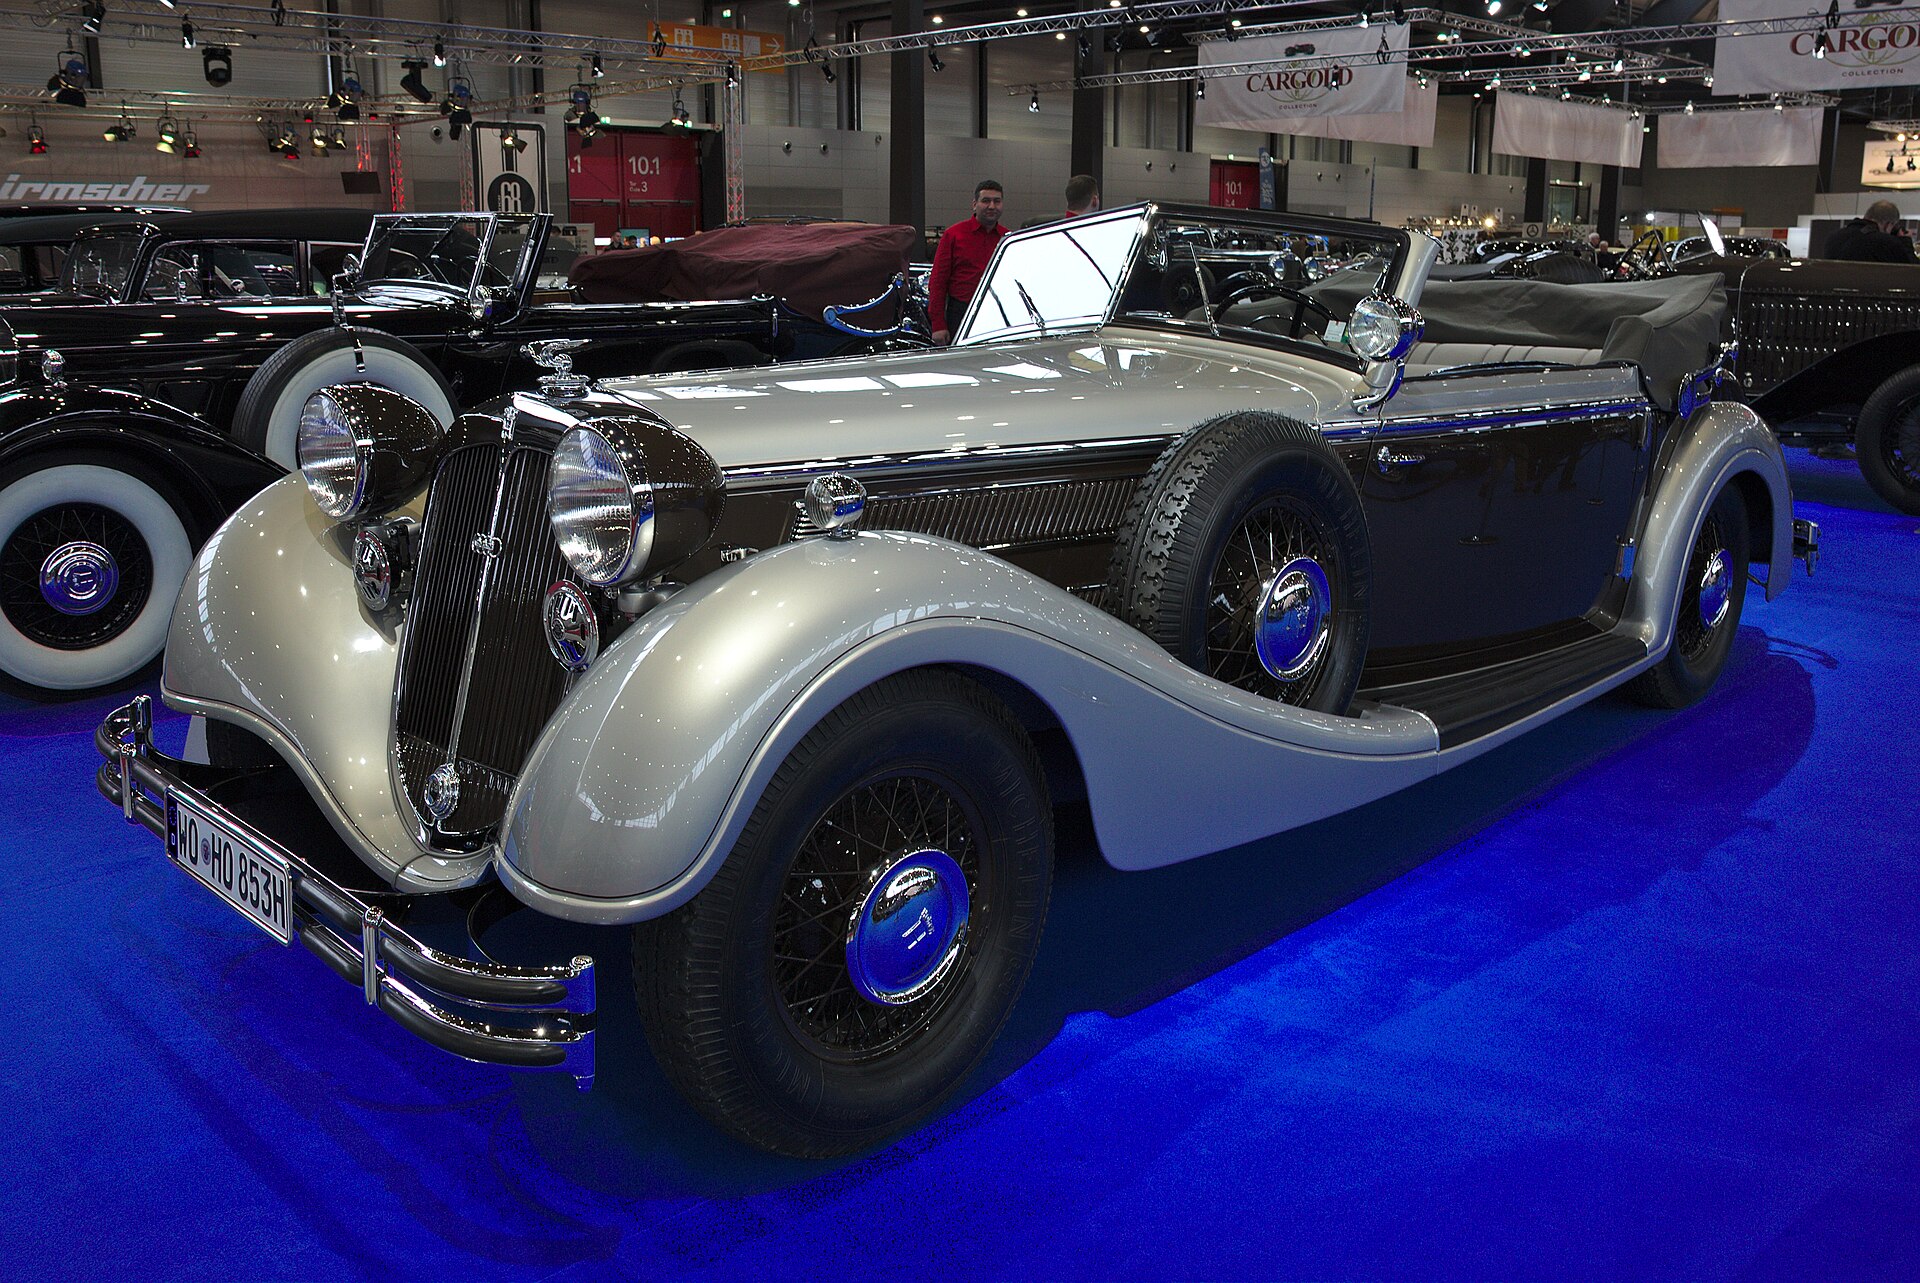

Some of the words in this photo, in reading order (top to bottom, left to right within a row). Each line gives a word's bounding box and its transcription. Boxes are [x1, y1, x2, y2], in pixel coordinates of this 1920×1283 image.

[1790, 24, 1920, 56] CARGO
[1841, 68, 1904, 77] COLLECTION
[628, 156, 660, 175] 10.1
[0, 174, 211, 202] irmscher
[500, 181, 521, 213] 68
[641, 181, 648, 193] 3
[1225, 181, 1242, 196] 10.1
[178, 810, 198, 866] WO
[212, 832, 233, 891] HO
[239, 852, 286, 930] 853H
